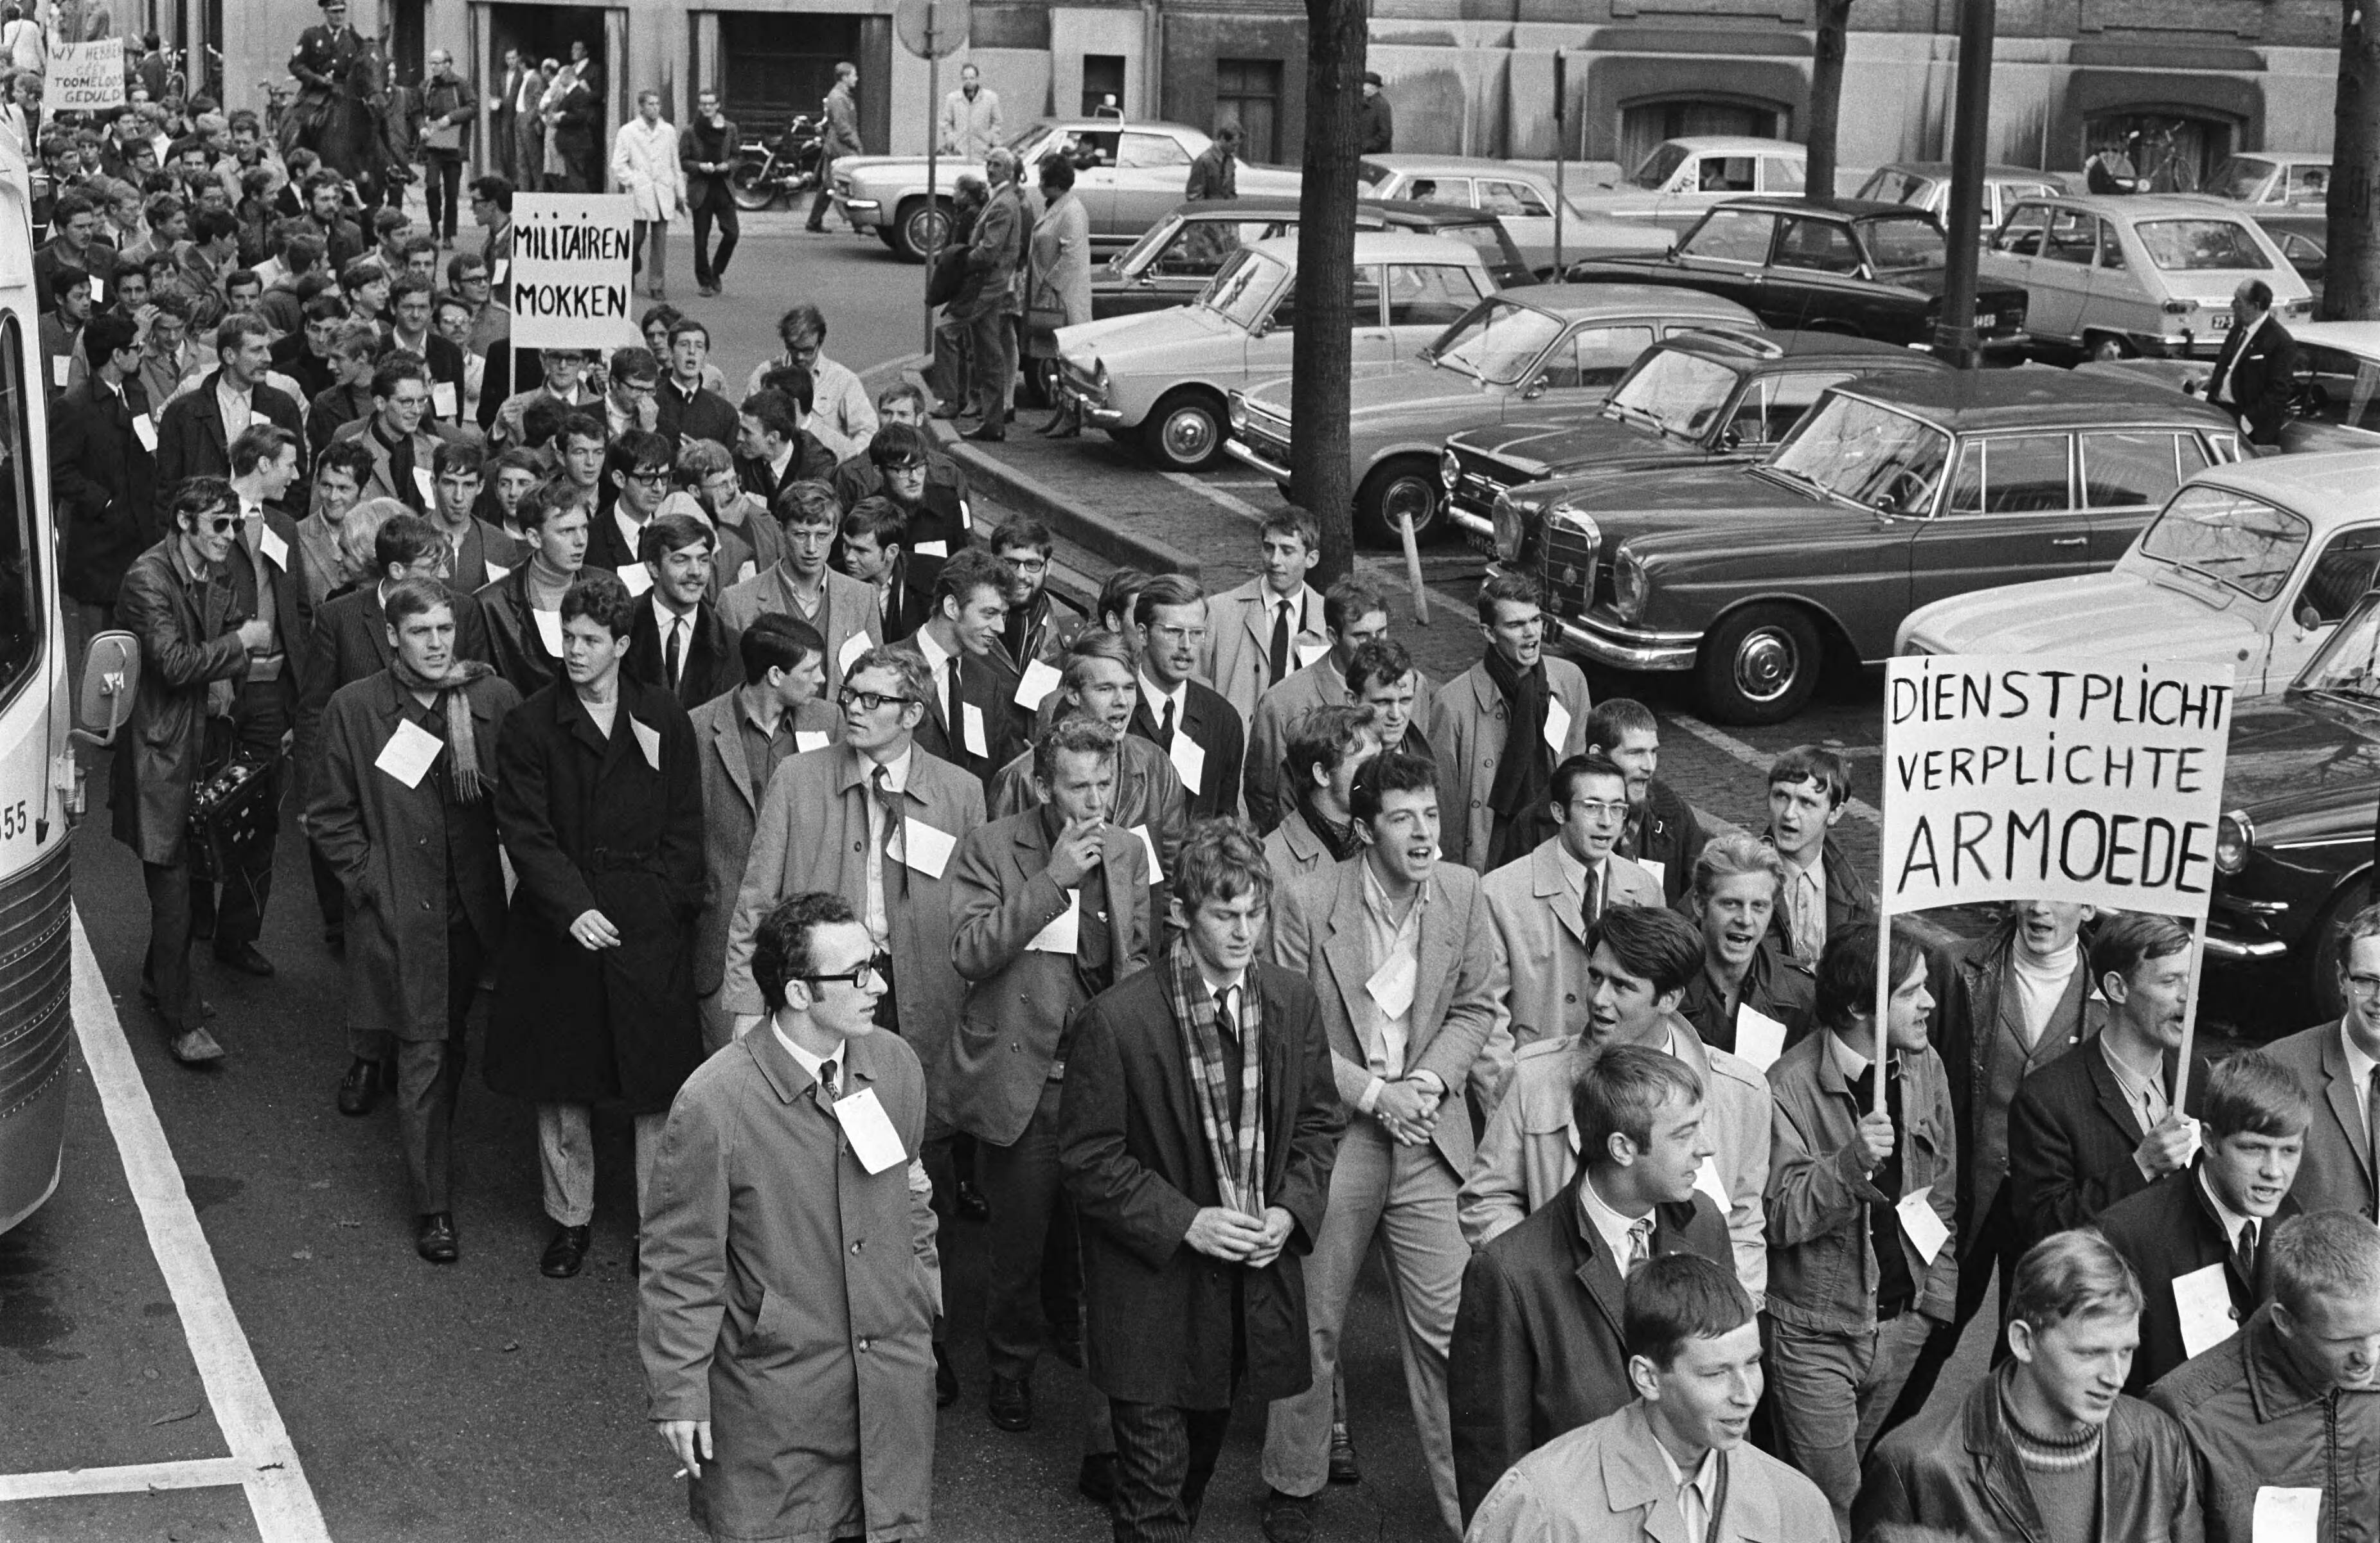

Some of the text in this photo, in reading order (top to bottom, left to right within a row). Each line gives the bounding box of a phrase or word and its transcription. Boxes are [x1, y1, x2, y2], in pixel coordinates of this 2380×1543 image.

[65, 89, 120, 103] GEDULD
[515, 282, 626, 319] MOKKEN
[0, 800, 26, 841] 55
[1897, 808, 2210, 894] ARMOEDE
